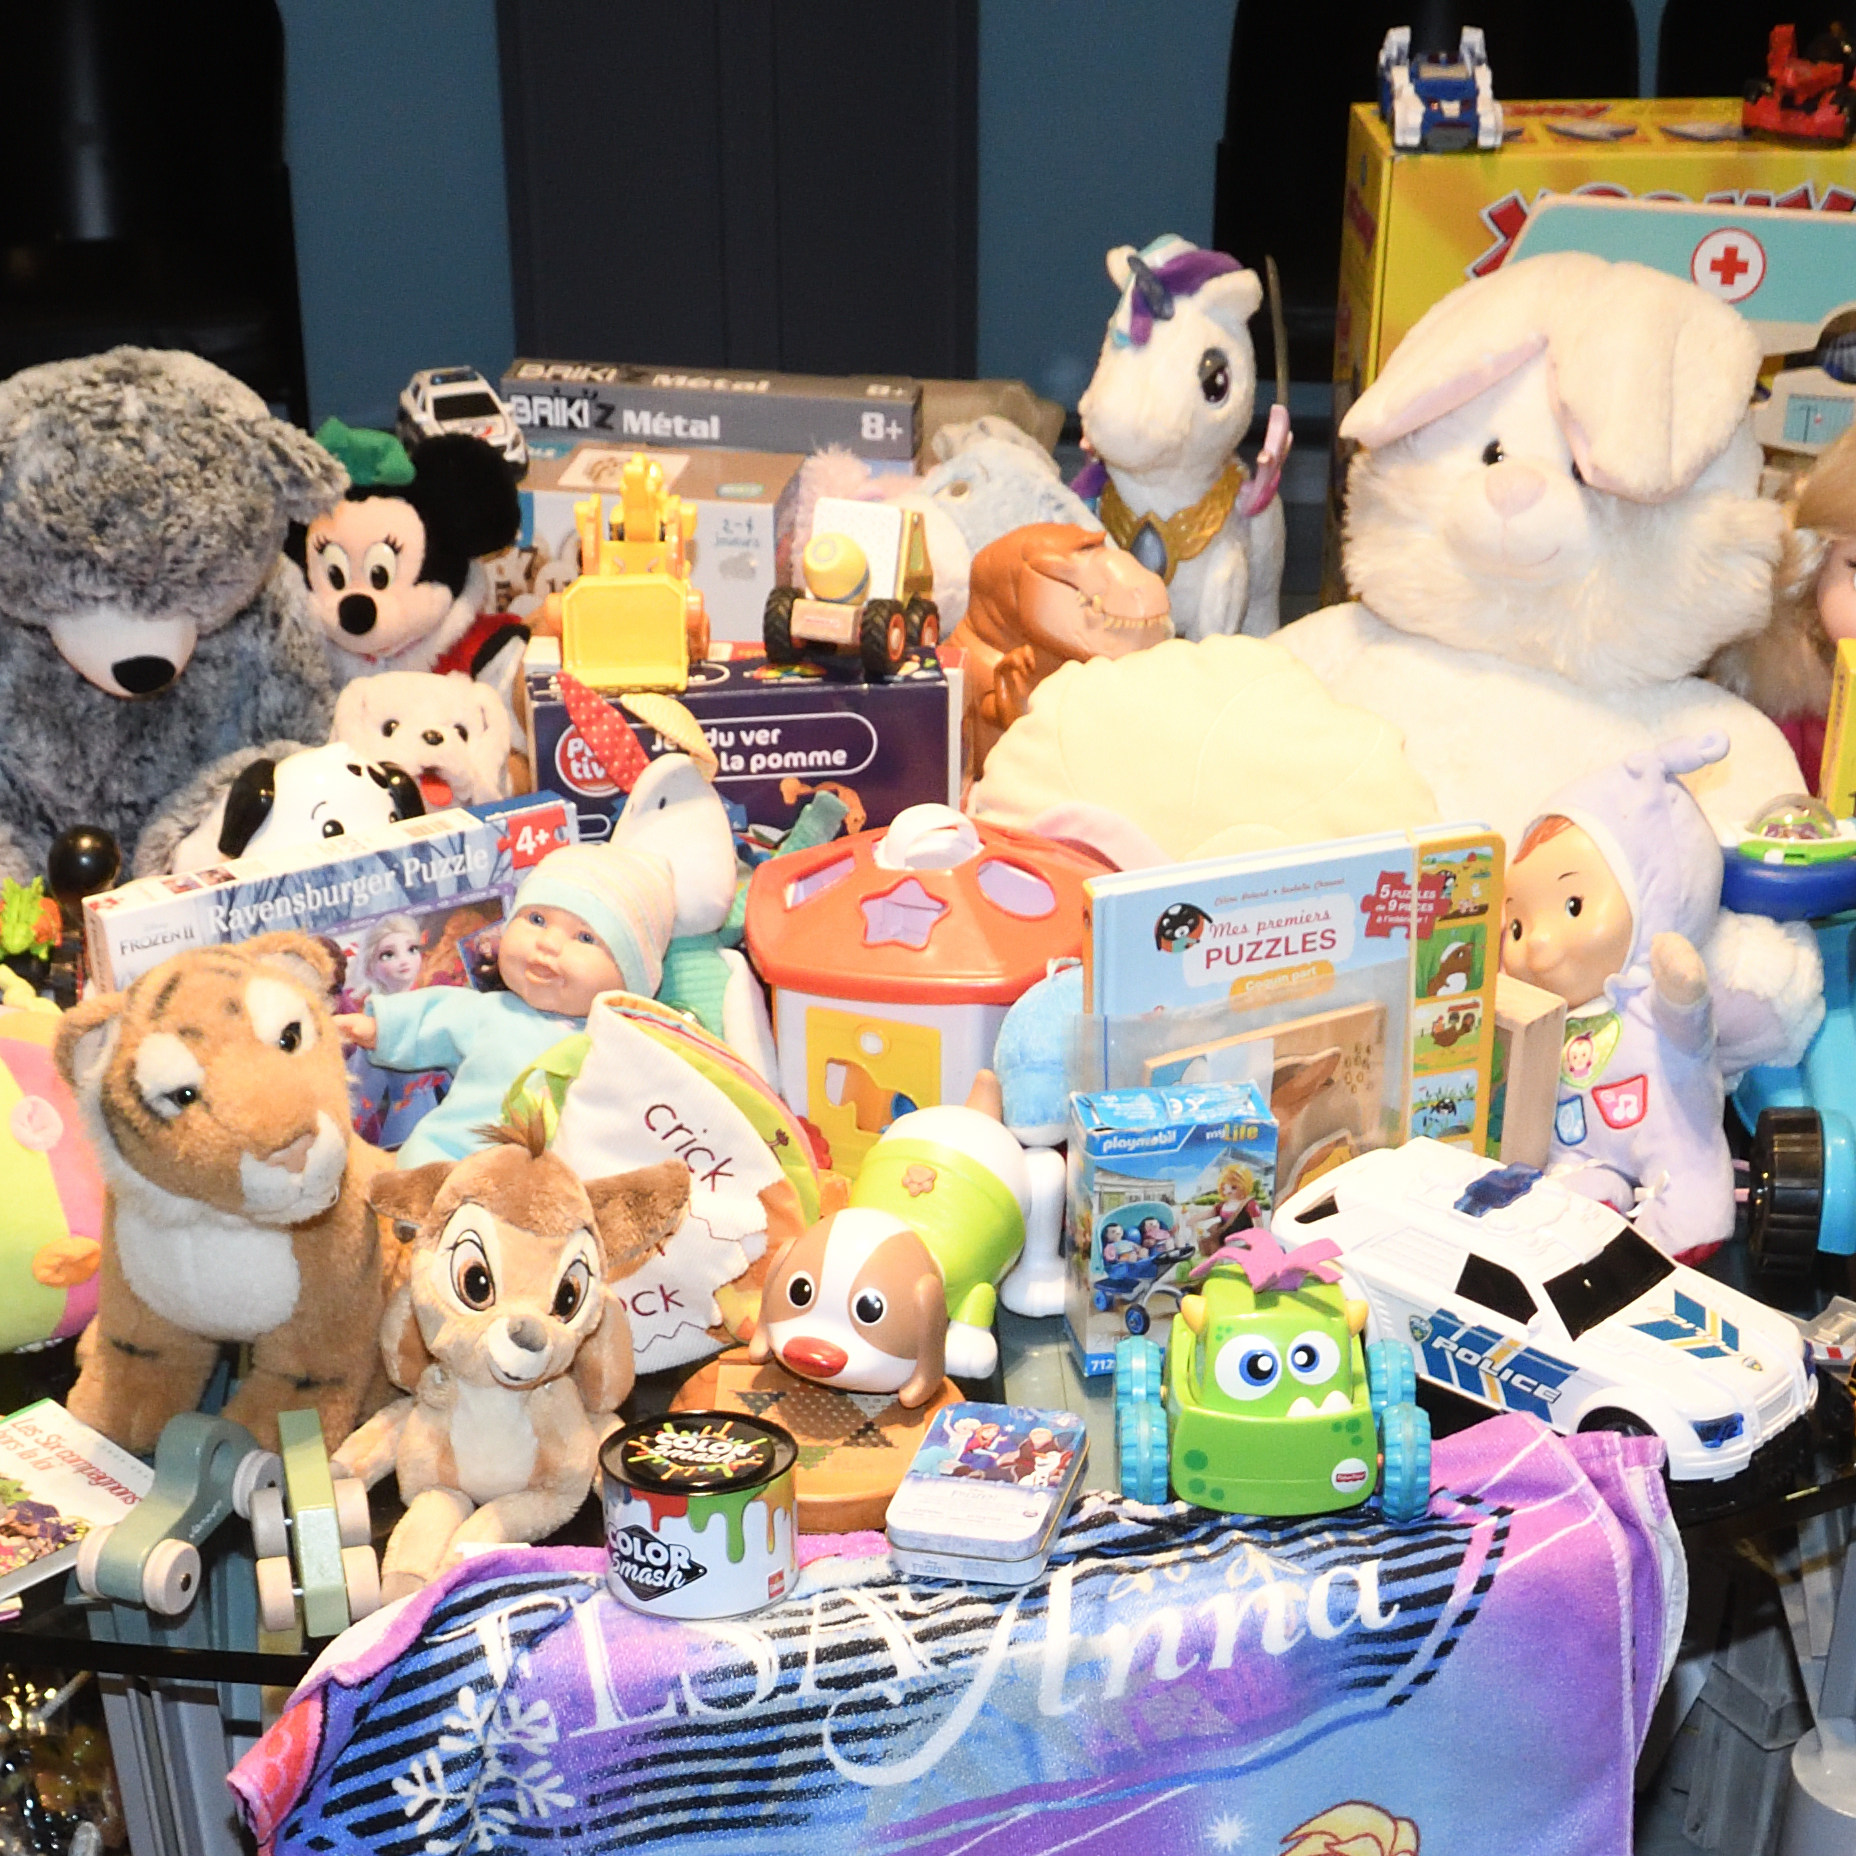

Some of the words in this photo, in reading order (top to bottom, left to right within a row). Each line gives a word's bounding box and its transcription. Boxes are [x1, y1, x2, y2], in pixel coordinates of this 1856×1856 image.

[622, 409, 721, 441] Métal
[860, 410, 904, 443] 8+
[740, 728, 782, 747] ver
[721, 752, 744, 772] la
[750, 749, 848, 774] pomme
[515, 826, 551, 857] 4+
[207, 868, 398, 936] Ravensburger
[402, 844, 490, 889] Puzzle
[1208, 921, 1249, 938] Mes
[1255, 909, 1332, 936] premiers
[1205, 928, 1337, 969] PUZZLES
[644, 1101, 735, 1194] crick
[1102, 1128, 1177, 1154] playmobil
[1431, 1335, 1562, 1404] POLICE
[654, 1432, 752, 1456] COLOR
[606, 1525, 692, 1571] COLOR
[608, 1549, 687, 1590] Smash
